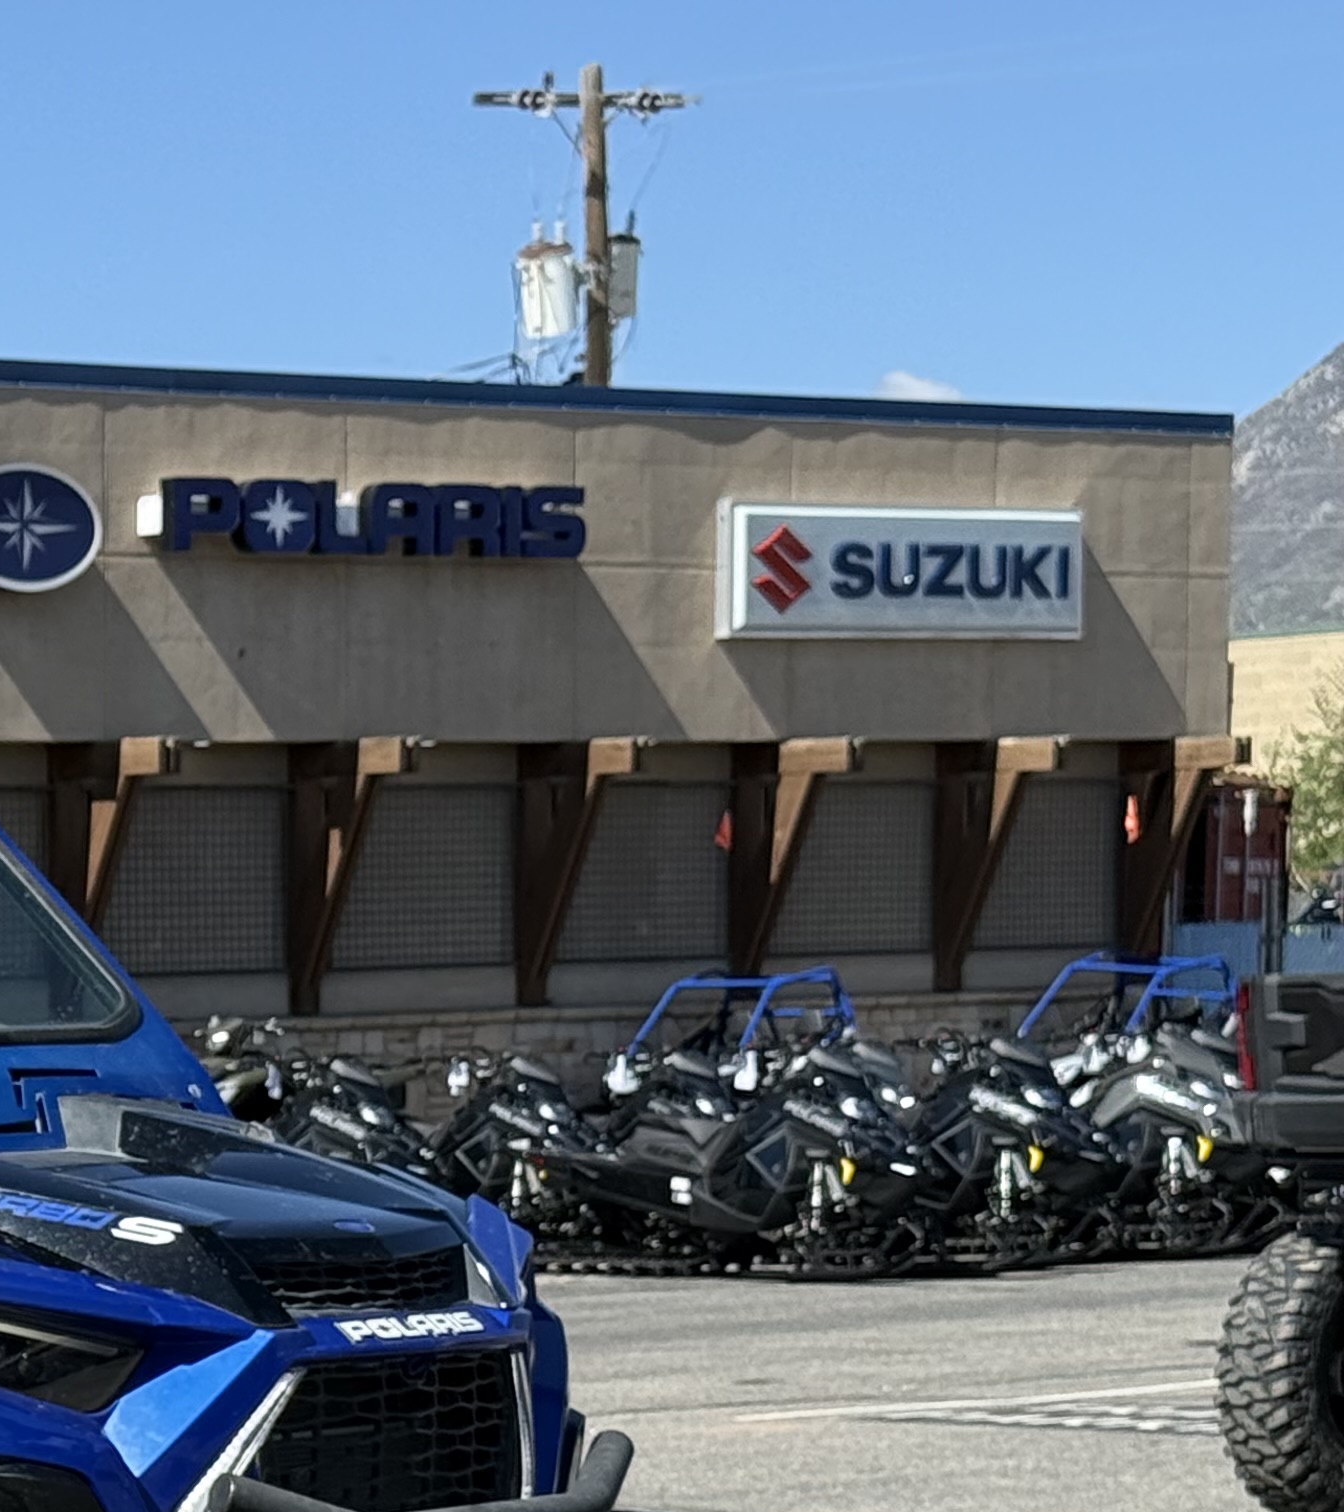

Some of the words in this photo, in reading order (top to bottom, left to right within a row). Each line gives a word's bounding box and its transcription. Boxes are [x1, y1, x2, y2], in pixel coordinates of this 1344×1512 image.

[161, 477, 587, 559] POLARIS
[829, 541, 1070, 600] SUZUKI
[110, 1216, 184, 1246] S
[333, 1311, 485, 1344] POLARIS
